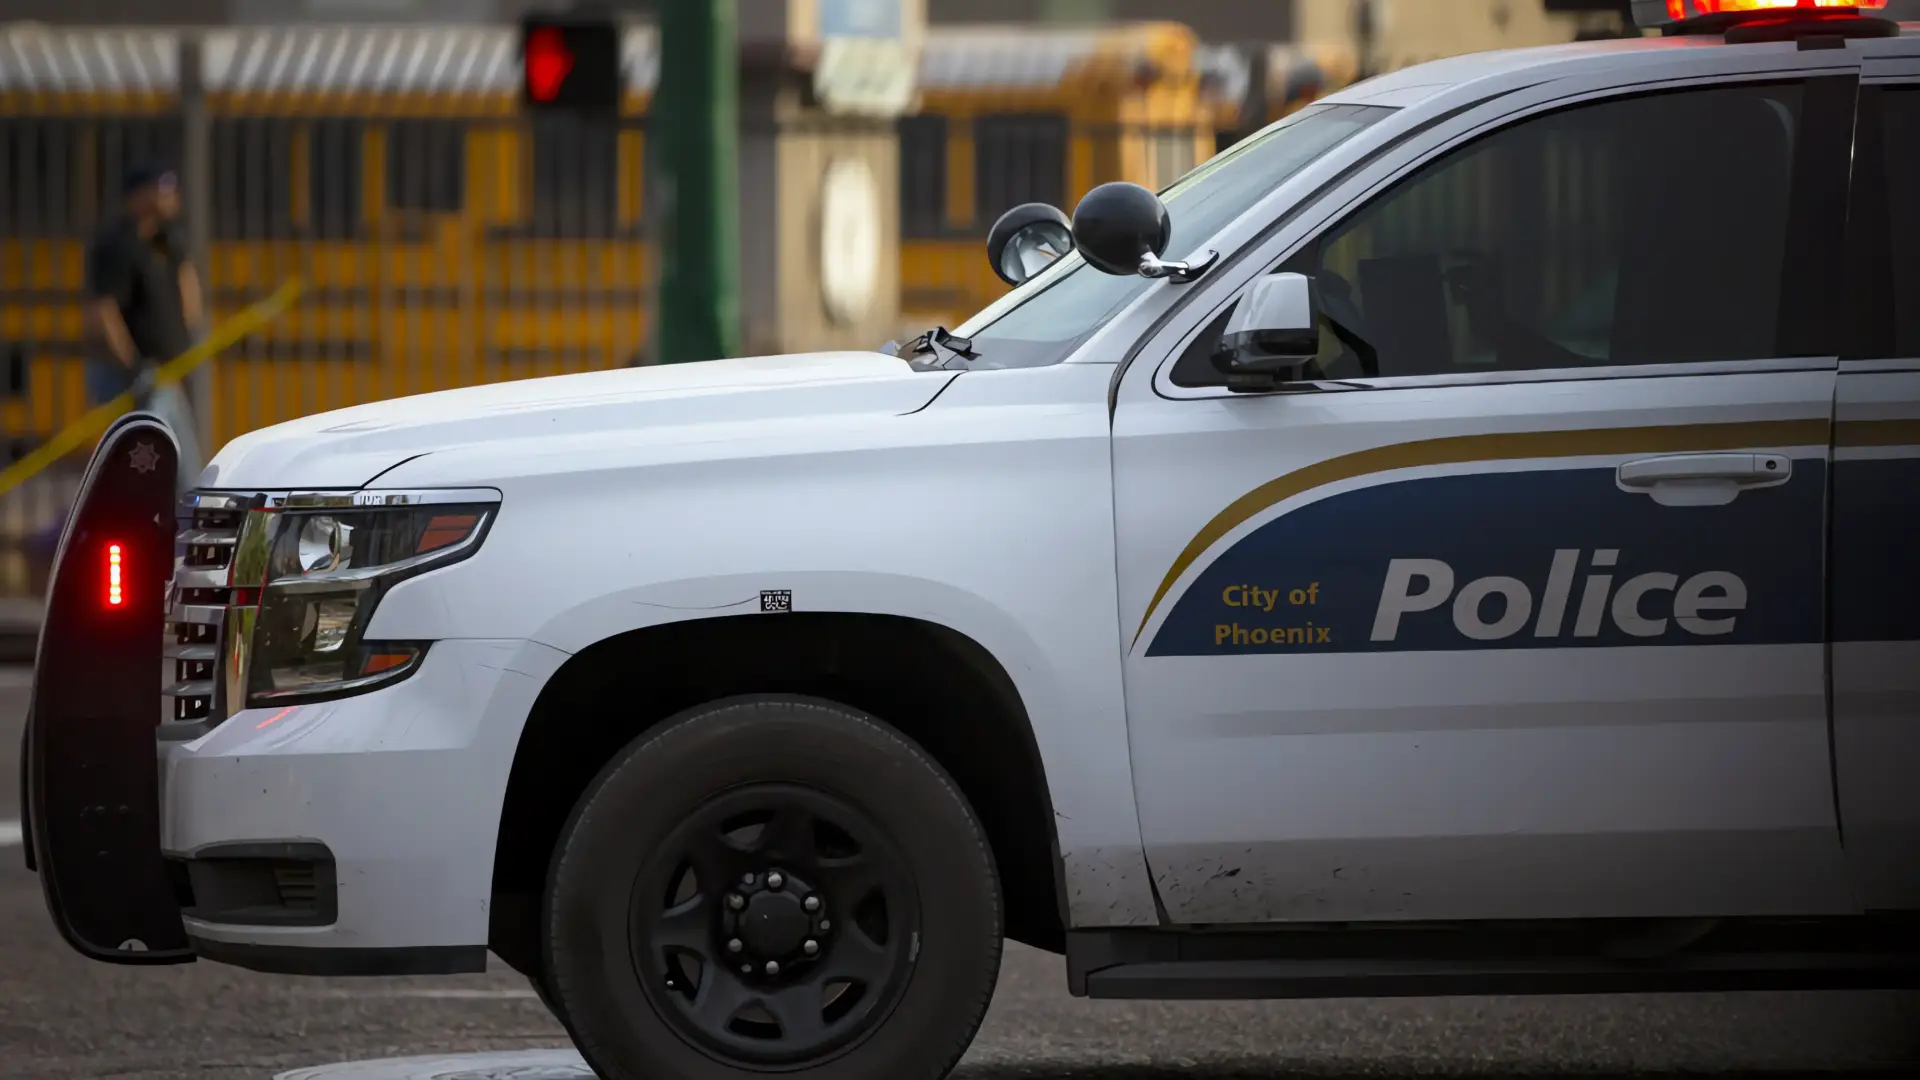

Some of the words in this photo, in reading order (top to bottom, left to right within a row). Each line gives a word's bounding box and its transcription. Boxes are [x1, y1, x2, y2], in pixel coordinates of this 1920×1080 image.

[1222, 584, 1279, 611] City
[1288, 582, 1320, 605] of
[1370, 549, 1747, 641] Police
[1215, 621, 1332, 645] Phoenix
